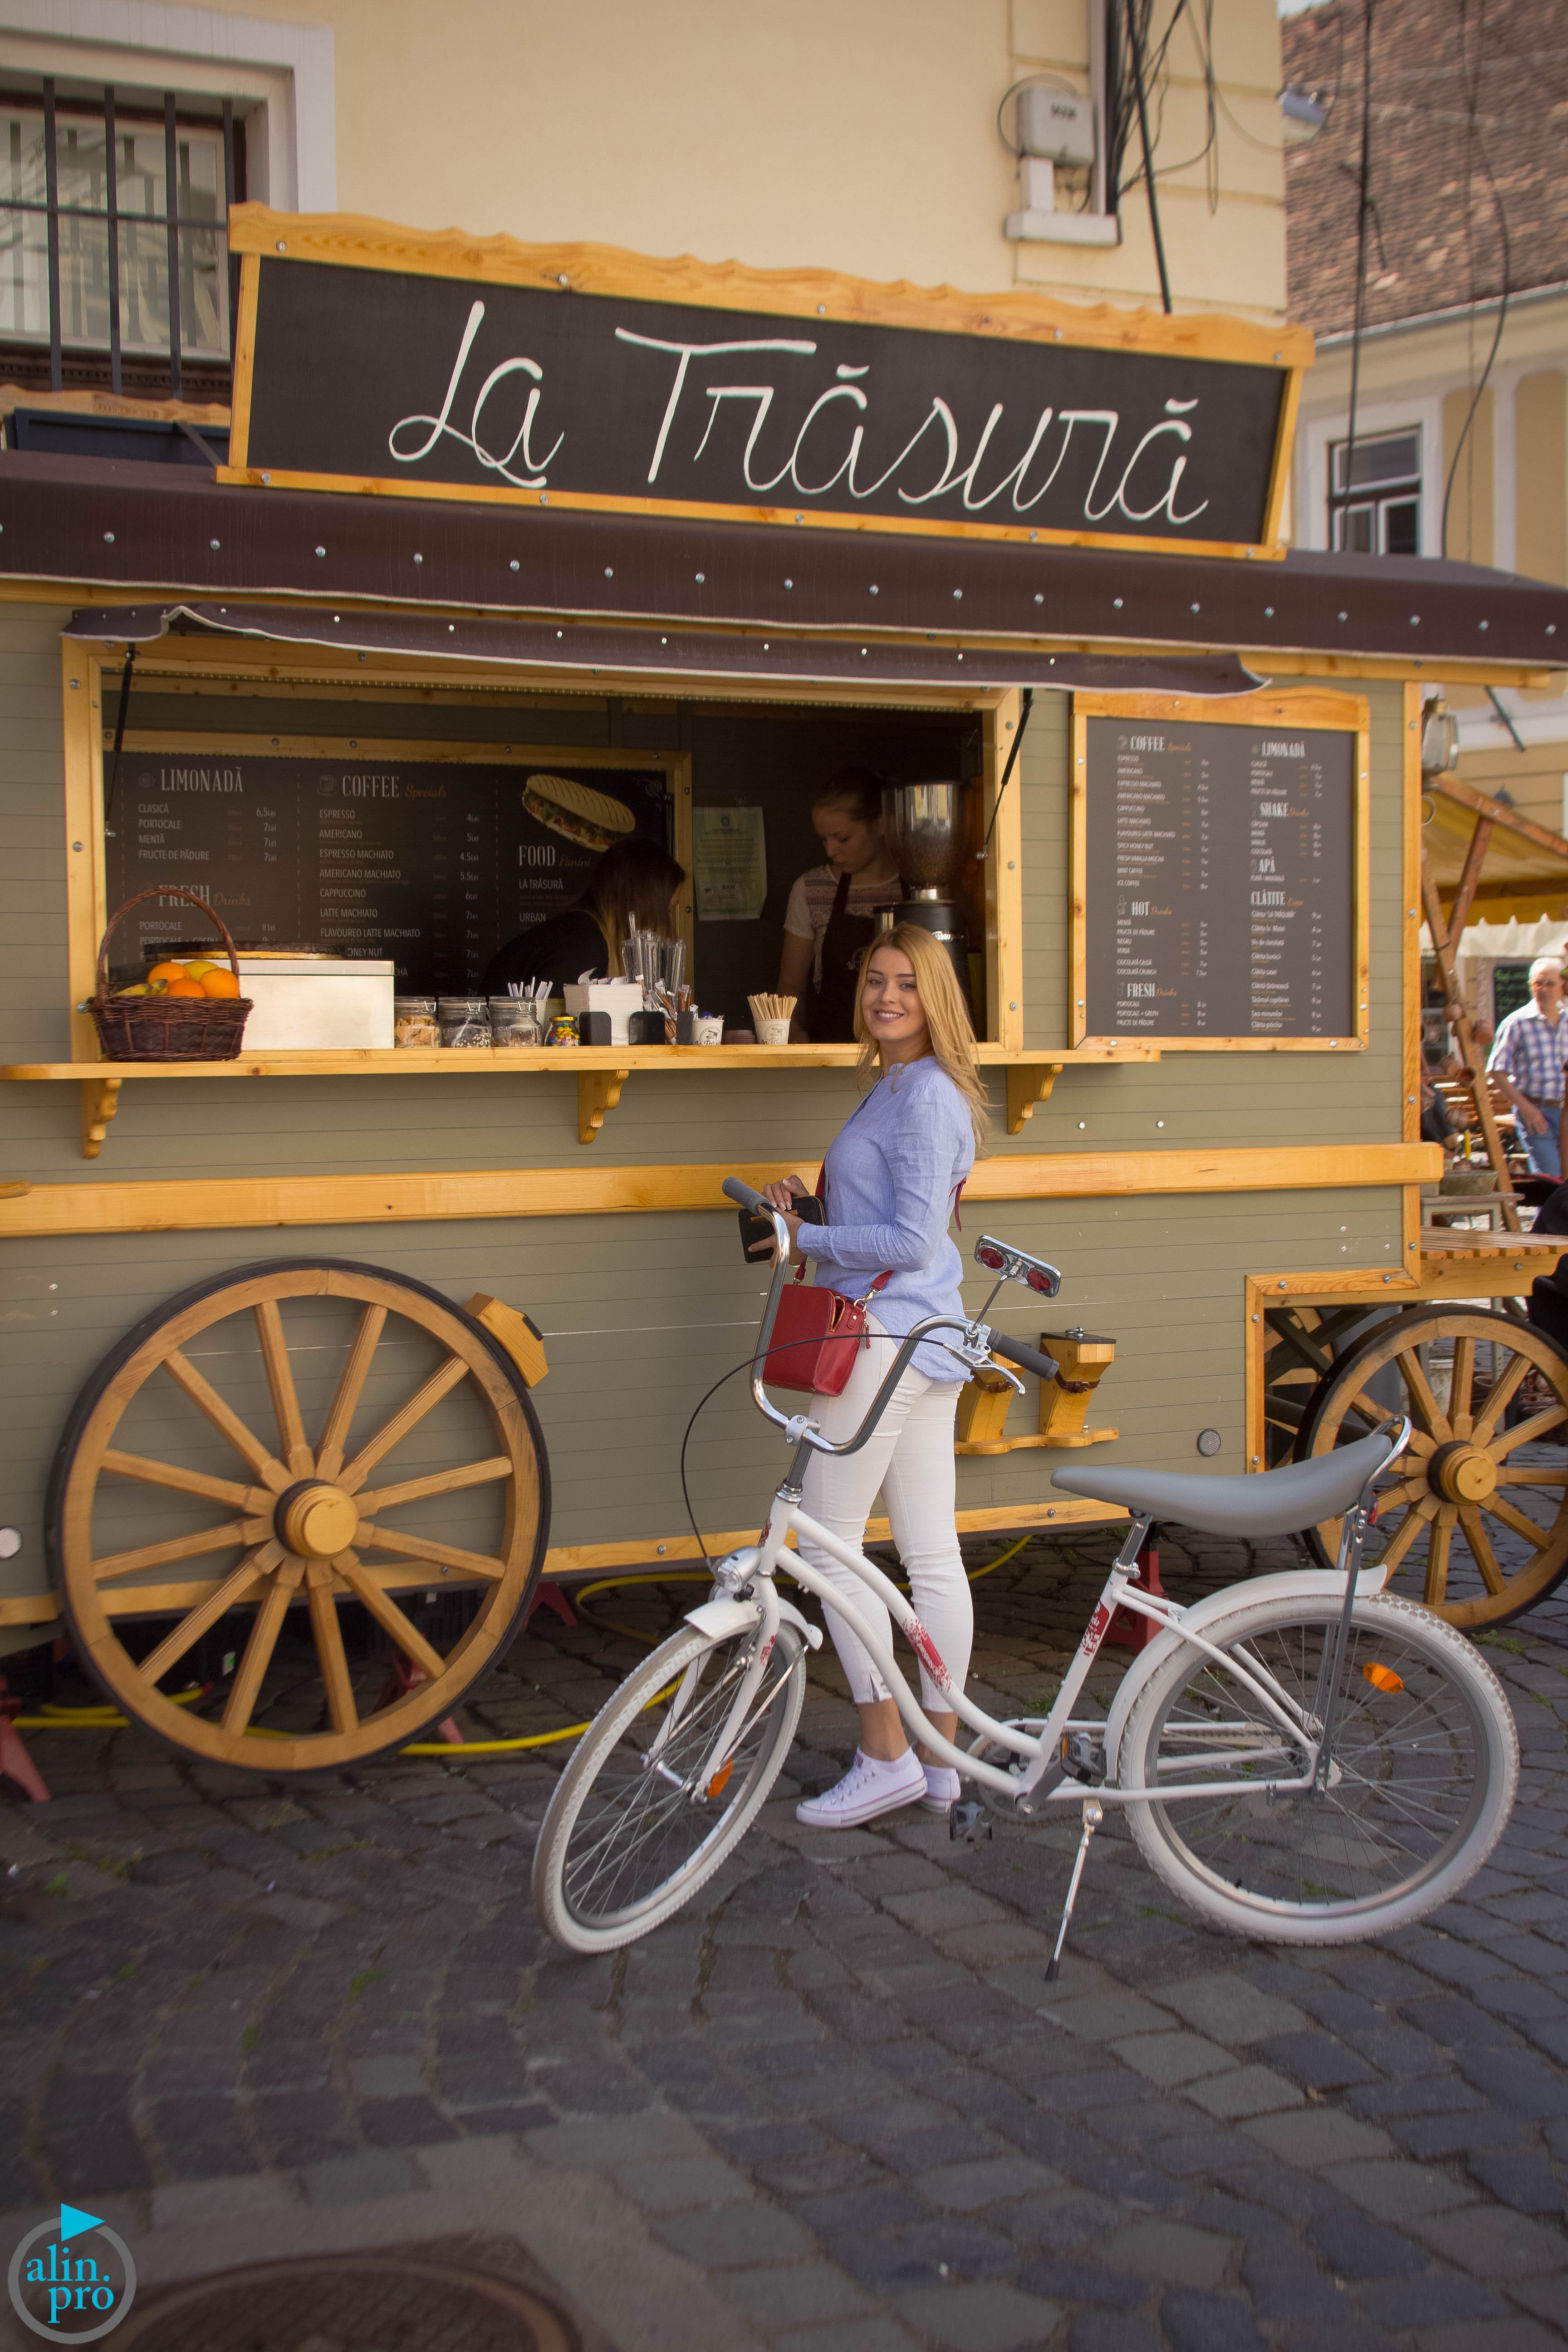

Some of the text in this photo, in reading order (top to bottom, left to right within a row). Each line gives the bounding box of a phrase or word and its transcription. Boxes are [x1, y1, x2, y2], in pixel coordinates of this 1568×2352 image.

[389, 299, 1209, 524] La Trăsură
[1130, 735, 1166, 752] COFFEE
[1261, 741, 1306, 759] LIMONADĂ
[161, 767, 243, 792] LIMONADĂ
[342, 775, 446, 800] COFFEE Specials
[138, 803, 169, 813] CLASICĂ
[319, 809, 355, 819] ESPRESSO
[1259, 802, 1289, 818] SHAKE
[138, 819, 181, 829] PORTOCALE
[138, 833, 165, 844] MENTĂ
[319, 829, 363, 839] AMERICANO
[138, 849, 167, 859] FRUCTE
[168, 850, 178, 859] DE
[180, 848, 210, 861] PĂDURE
[319, 848, 355, 859] ESPRESSO
[357, 849, 394, 860] MACHIATO
[519, 845, 592, 868] FOOD Panini
[1258, 856, 1276, 874] APĂ
[319, 868, 363, 879] AMERICANO
[364, 869, 402, 880] MACHIATO
[519, 877, 564, 890] LA TRĂSURĂ
[214, 892, 251, 906] Drinks
[320, 888, 367, 899] CAPPUCCINO
[320, 908, 339, 917] LATTE
[341, 908, 378, 919] MACHIATO
[1131, 901, 1151, 916] HOT
[519, 912, 546, 923] URBAN
[139, 921, 182, 931] PORTOCALE
[320, 928, 362, 938] FLAVOURED
[363, 928, 382, 938] LATTE
[384, 929, 421, 939] MACHIATO
[368, 947, 383, 957] NUT
[1127, 983, 1155, 998] FRESH
